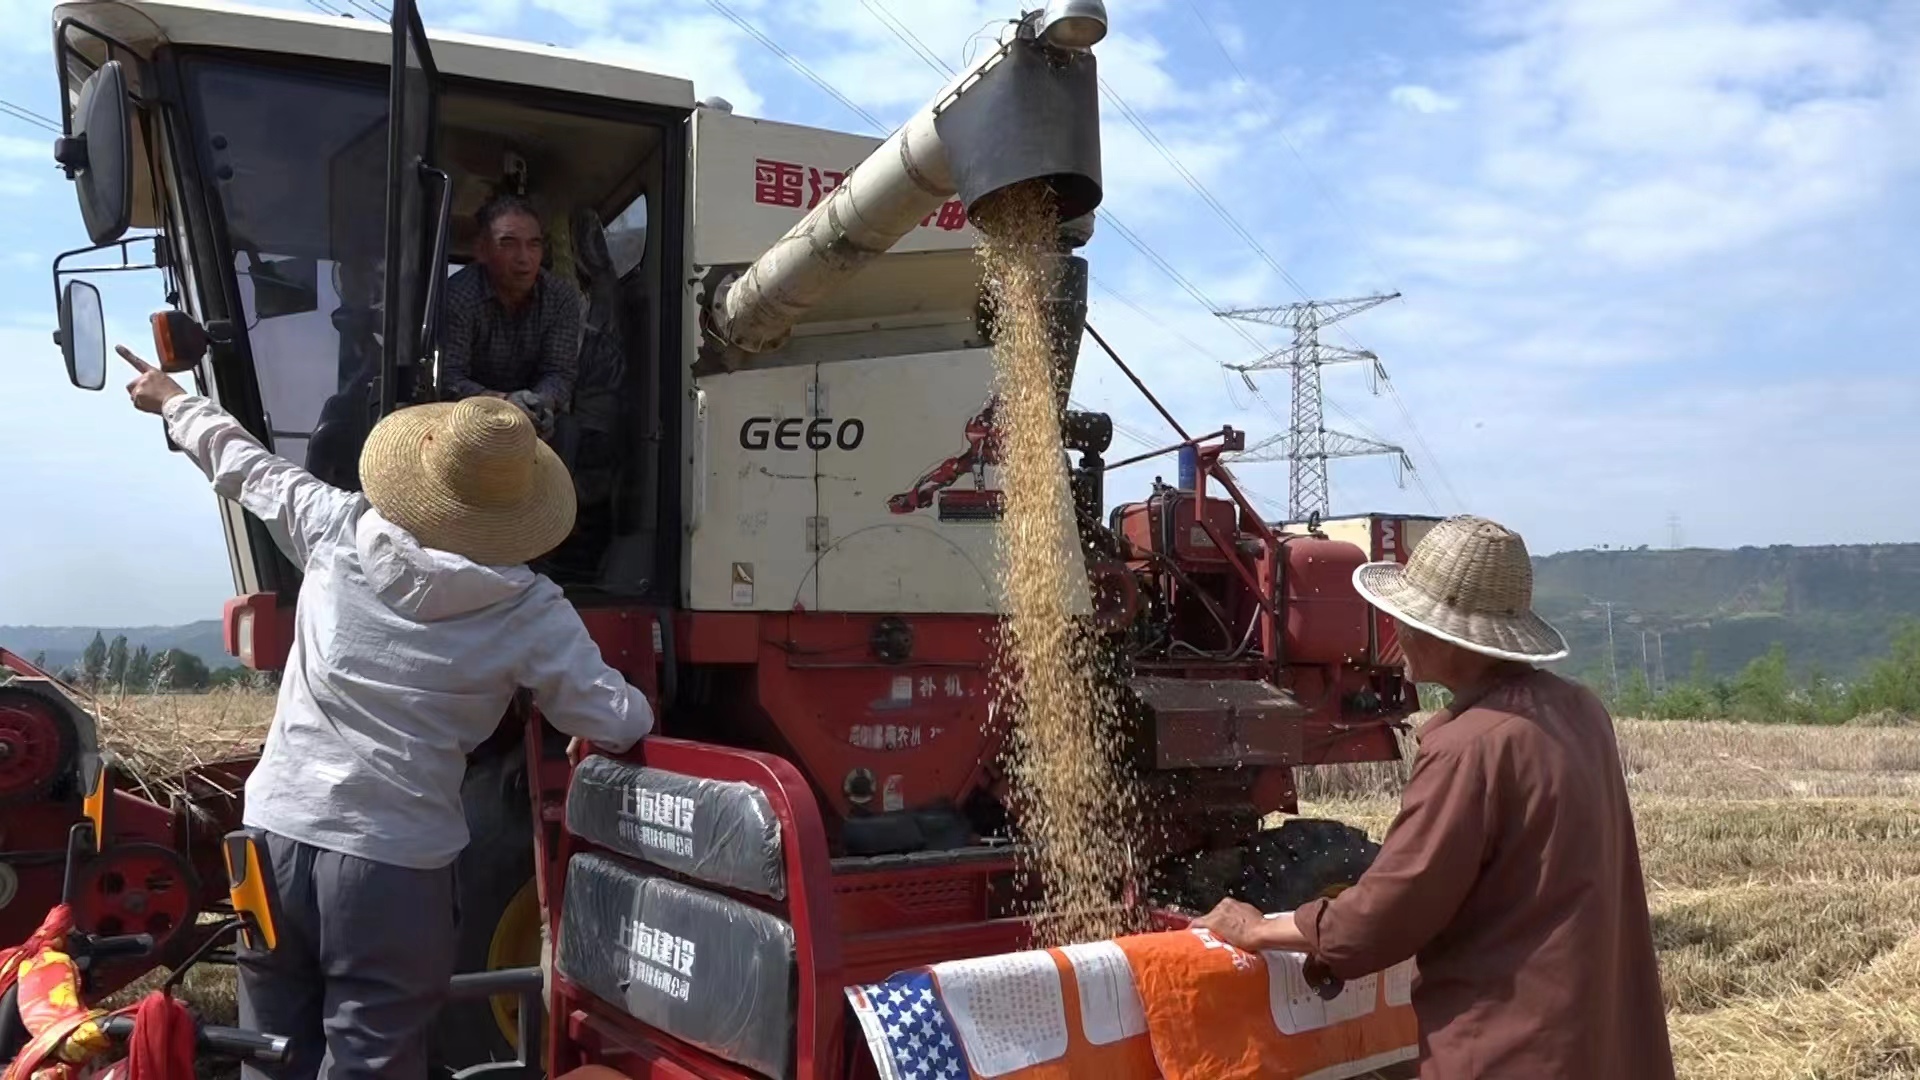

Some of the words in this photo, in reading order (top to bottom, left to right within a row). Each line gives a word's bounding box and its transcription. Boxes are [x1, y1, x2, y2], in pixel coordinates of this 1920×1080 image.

[739, 417, 865, 451] GE60
[617, 784, 695, 833] 上海建设
[615, 914, 696, 977] 上海建设
